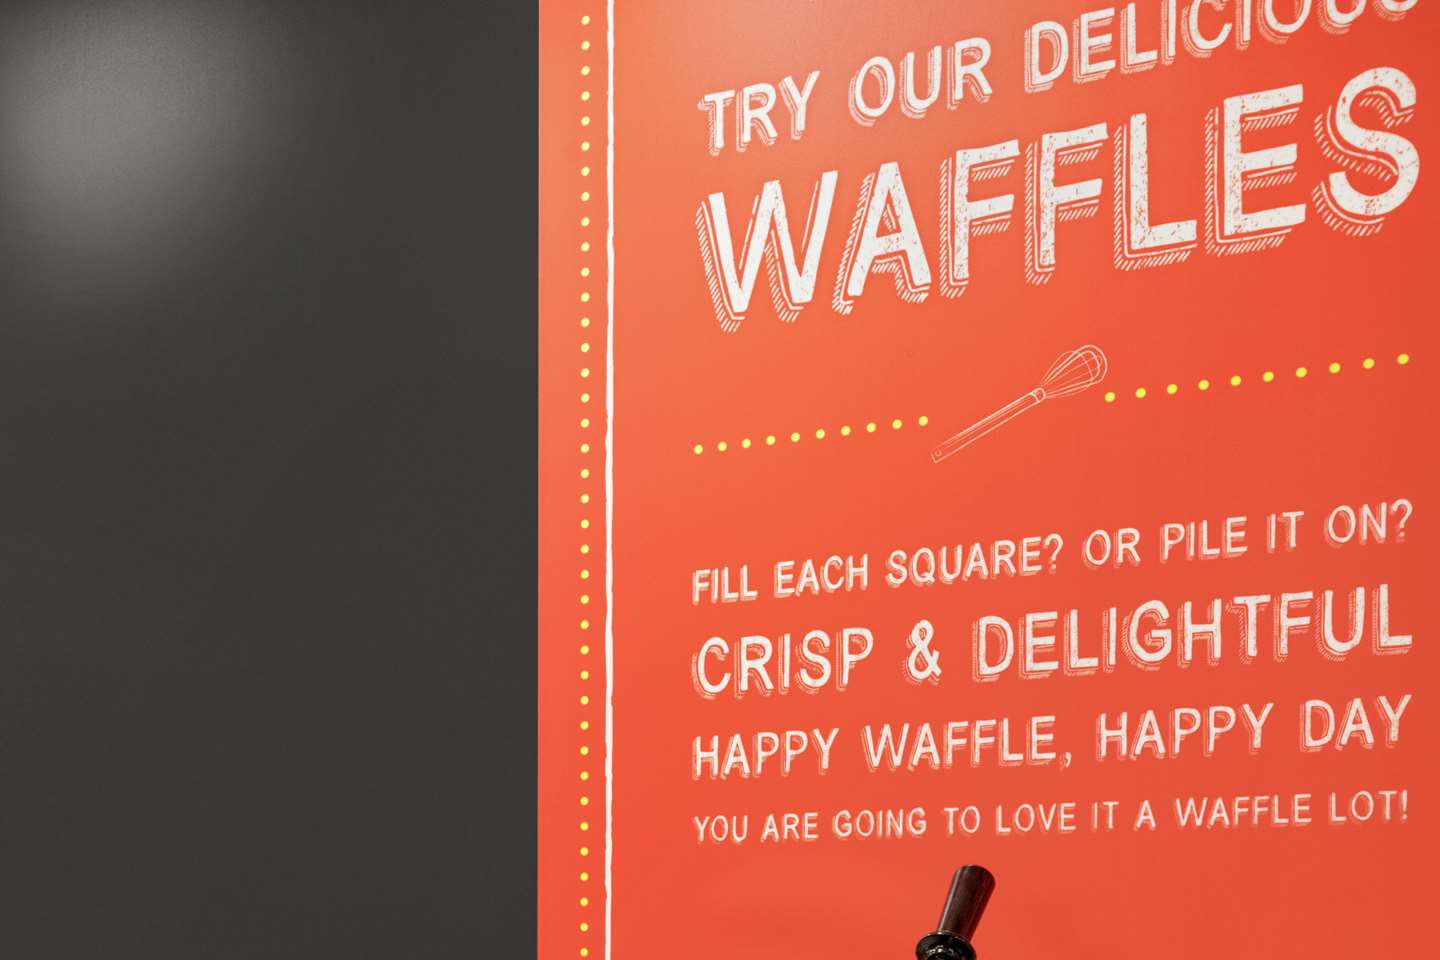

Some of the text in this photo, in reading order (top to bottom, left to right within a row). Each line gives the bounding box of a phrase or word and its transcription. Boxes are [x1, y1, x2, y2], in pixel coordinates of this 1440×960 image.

[697, 0, 1417, 155] TRY OUR DELICI
[696, 67, 1420, 331] WAFFLES
[692, 499, 1413, 603] FILL EACH SQUARE? OR PILE IT ON?
[694, 584, 1412, 697] CRISP & DELIGHTFUL
[693, 694, 1412, 778] HAPPY WAFFLE, HAPPY DAY
[695, 790, 1408, 843] YOU ARE GOING TO LOVE IT A WAFFLE LOT!
